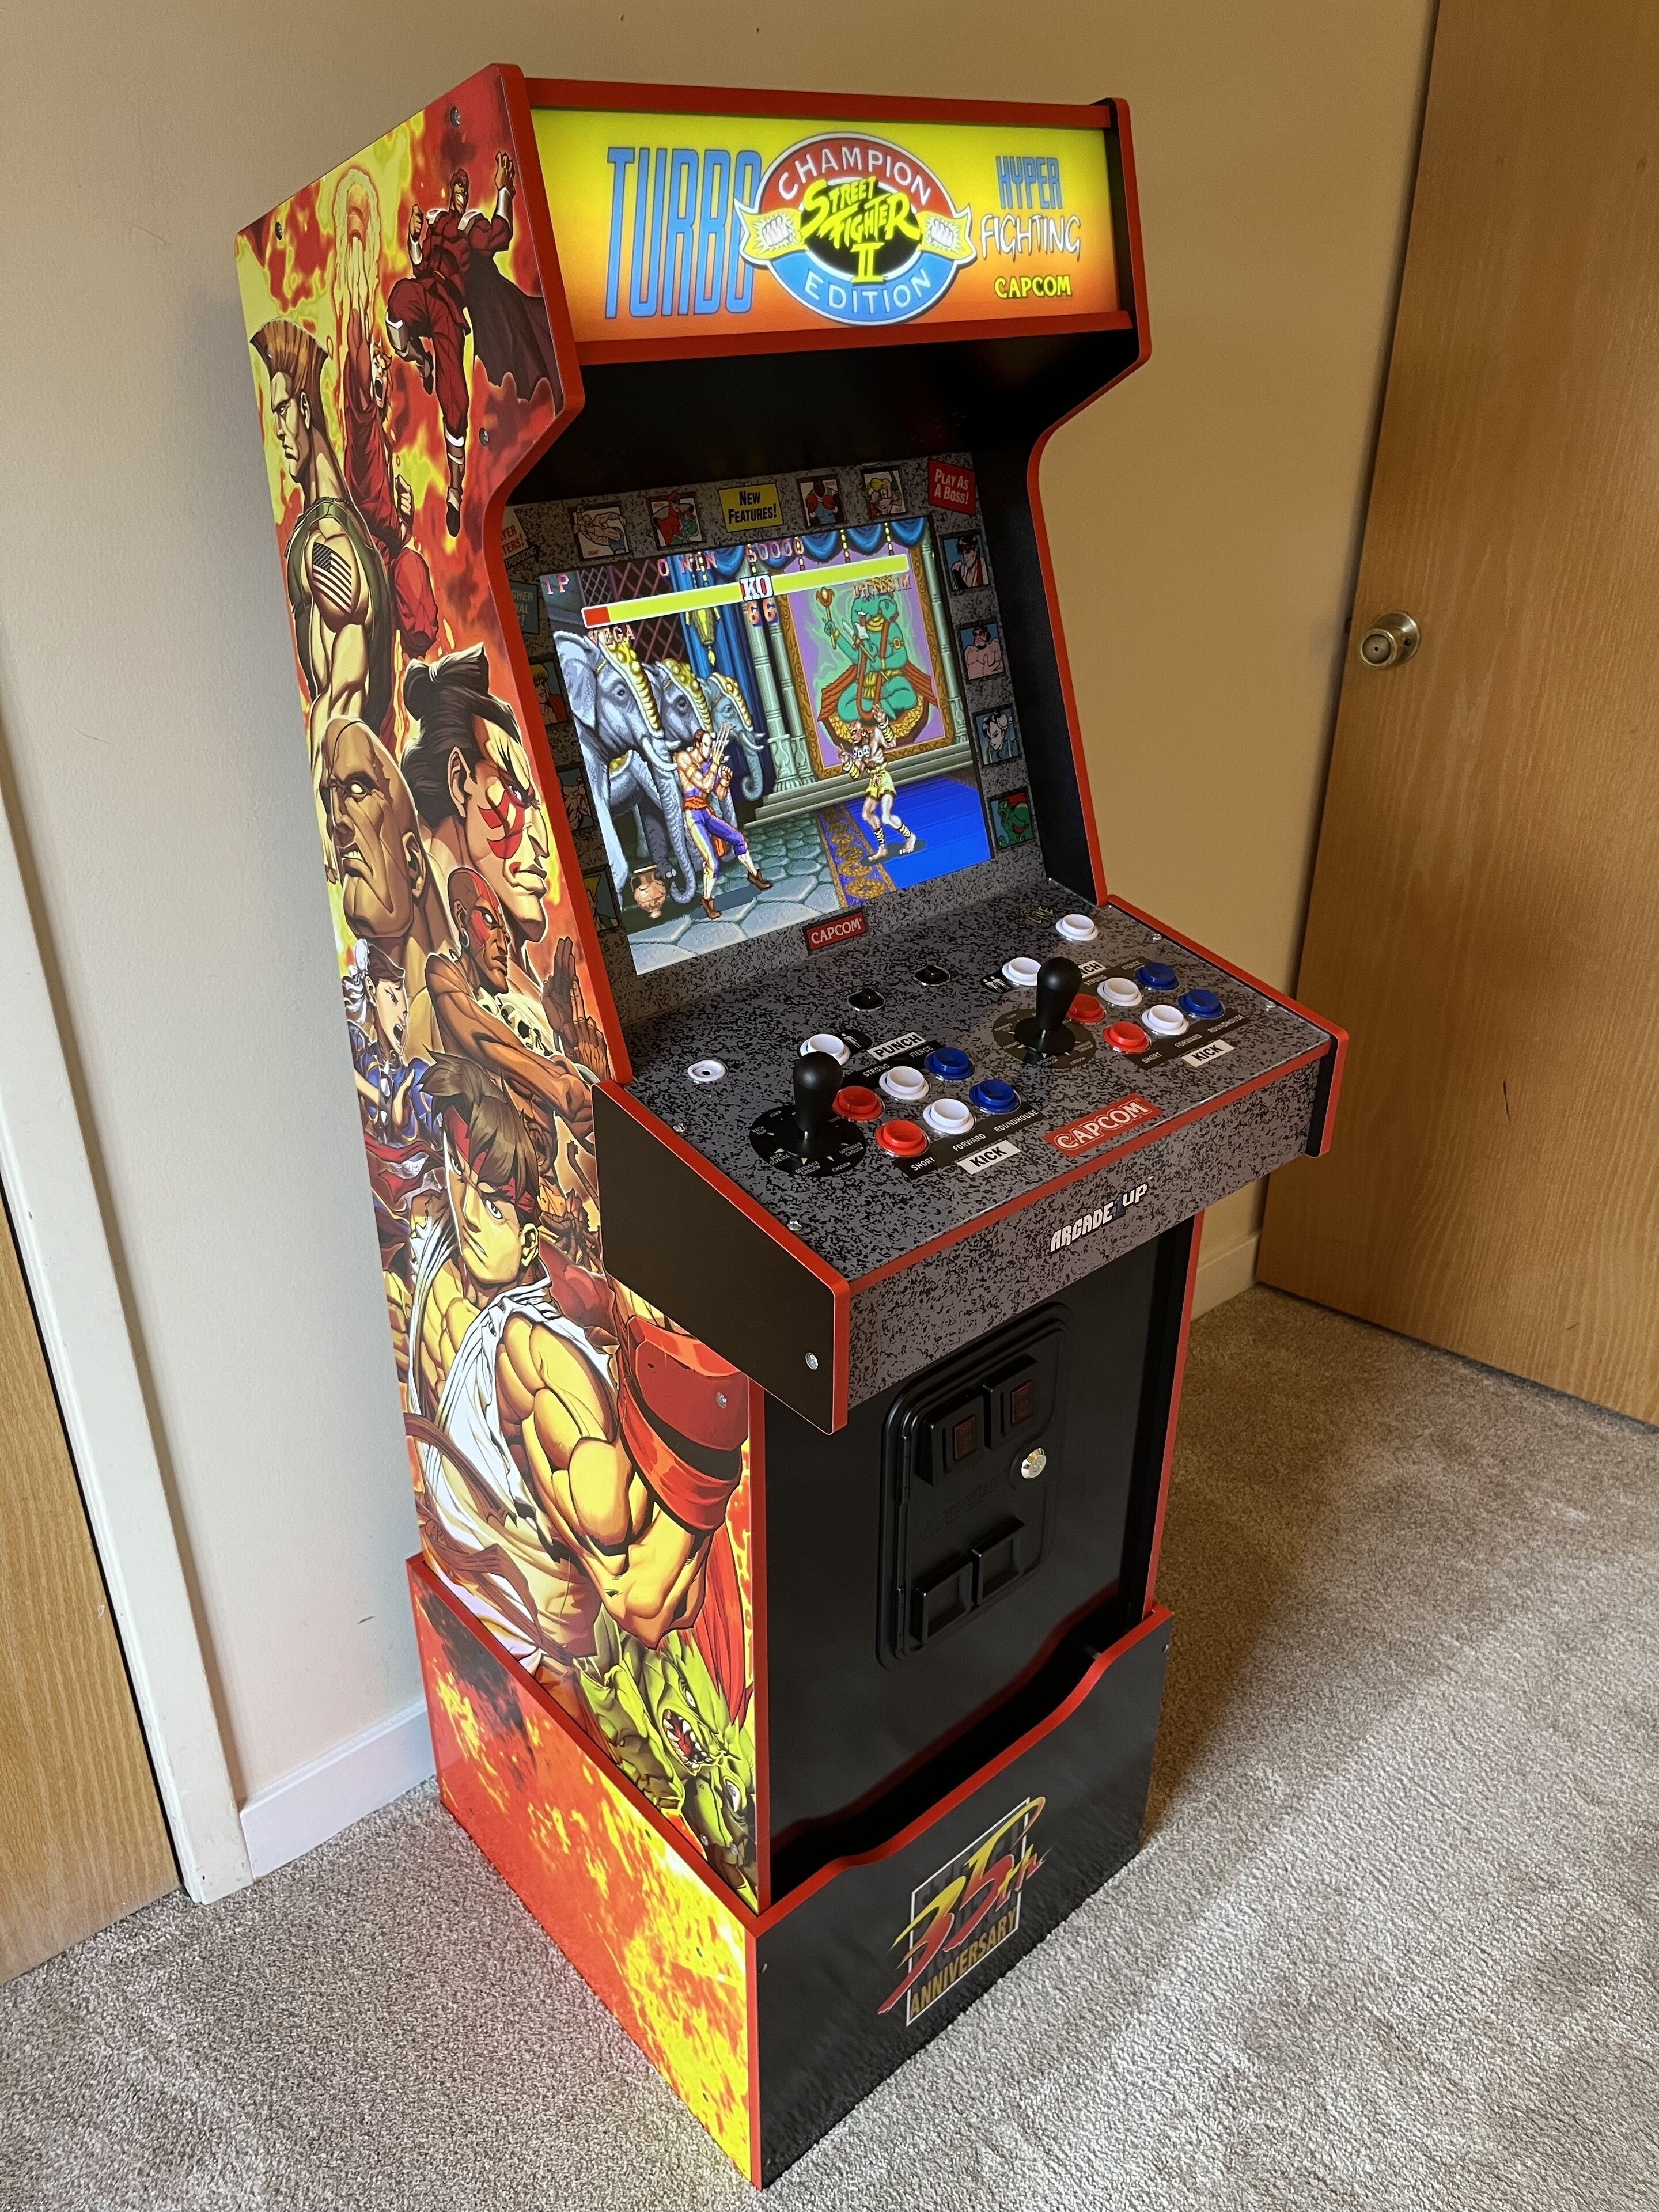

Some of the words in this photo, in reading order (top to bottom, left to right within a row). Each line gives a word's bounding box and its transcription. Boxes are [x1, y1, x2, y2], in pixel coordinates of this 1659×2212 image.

[778, 146, 931, 206] CHAMPION
[995, 156, 1063, 209] HYPER
[800, 176, 876, 241] STREET
[818, 192, 922, 249] FIGHTER
[605, 147, 762, 319] TURBO
[980, 214, 1081, 262] FIGHTING
[804, 267, 931, 314] EDITION
[994, 274, 1072, 299] CAPCOM
[934, 483, 941, 498] A
[501, 525, 517, 542] YER
[501, 533, 525, 555] TERS!
[505, 546, 537, 569] TRODUCING
[741, 575, 774, 601] KO
[587, 624, 636, 646] VEGA
[810, 918, 862, 944] CAPCOM
[862, 1063, 890, 1077] STRONG
[909, 1045, 933, 1058] FIERCE
[873, 1035, 922, 1058] PUNCH
[1141, 1052, 1162, 1063] SHORT
[1174, 1033, 1203, 1048] FORWARD
[1191, 1044, 1224, 1062] KICK
[1055, 1100, 1152, 1149] CAPCOM
[911, 1156, 936, 1171] SHORT
[952, 1133, 987, 1152] FORWARD
[993, 1109, 1040, 1132] ROUNDHOUSE
[969, 1146, 1007, 1168] KICK
[908, 1906, 1017, 2021] ANNIVERSARY
